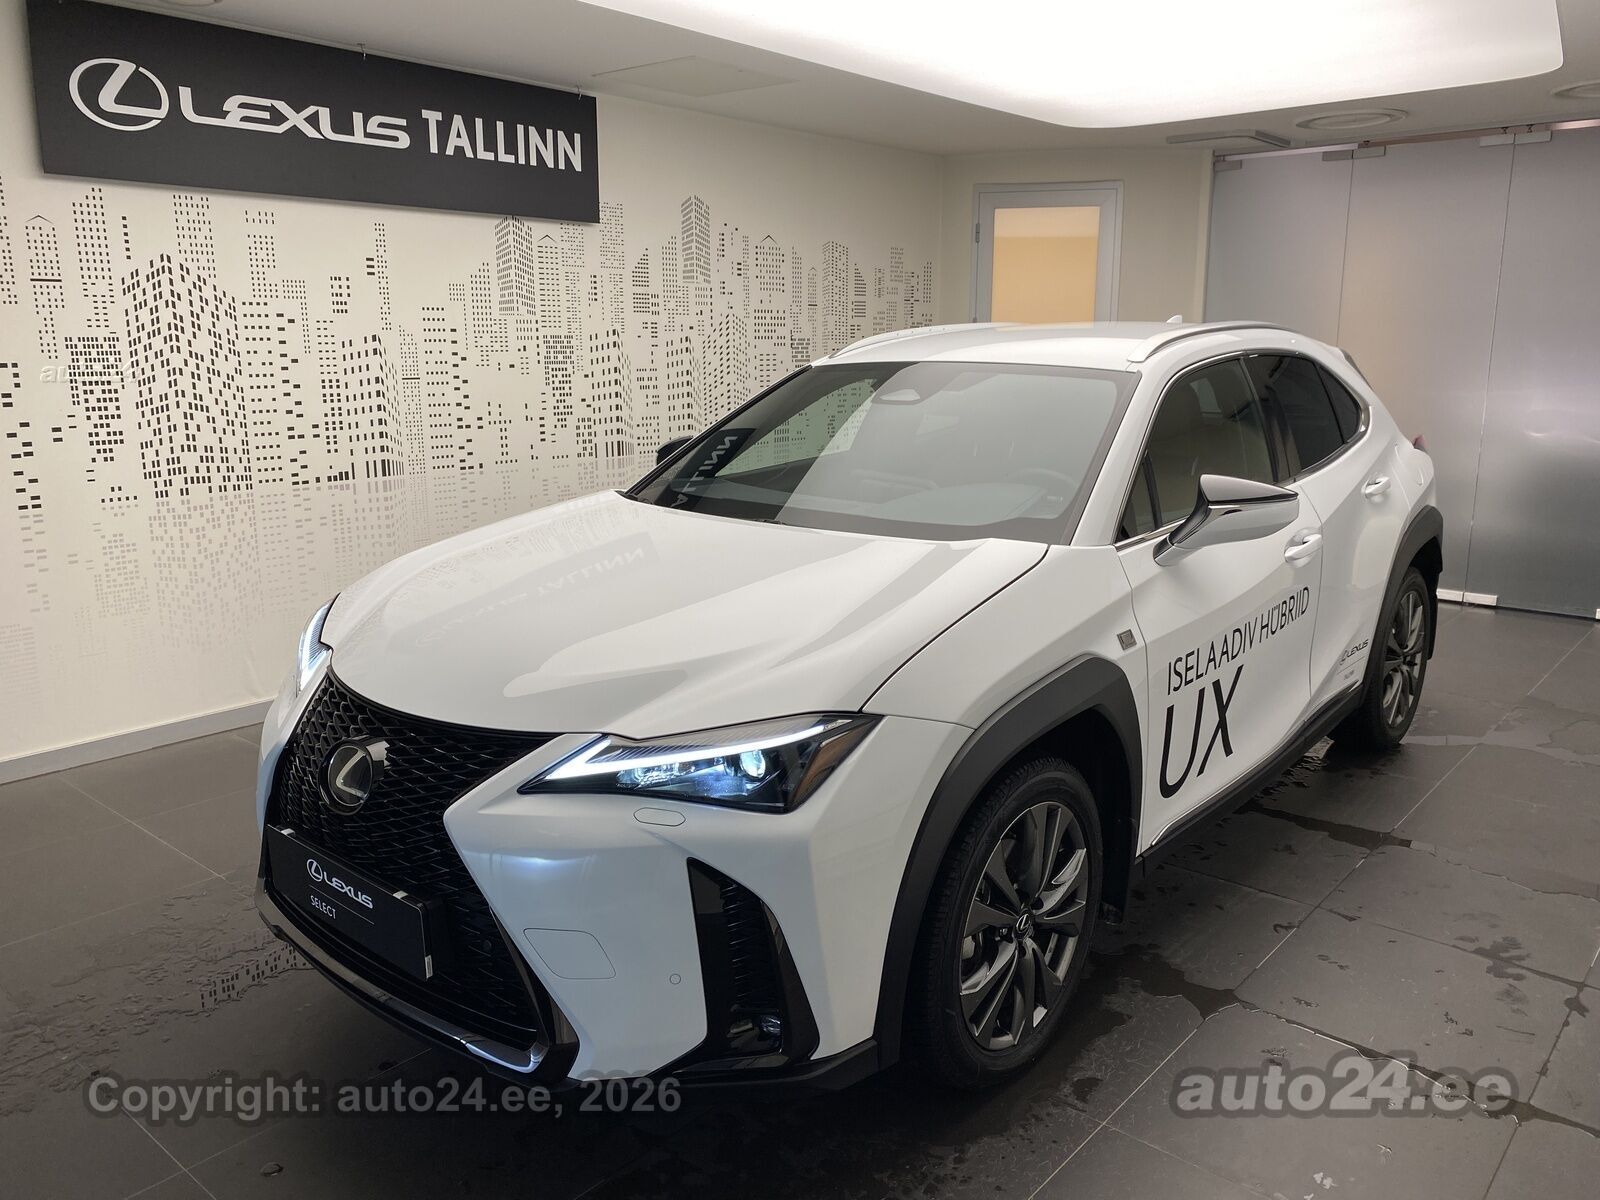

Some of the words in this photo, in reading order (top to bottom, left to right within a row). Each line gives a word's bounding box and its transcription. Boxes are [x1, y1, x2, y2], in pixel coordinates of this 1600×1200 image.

[178, 86, 411, 149] LEXUS
[421, 109, 582, 172] TALLINN
[1167, 617, 1258, 695] ISELAADIV
[1259, 586, 1310, 643] HÜBRIID
[1159, 664, 1244, 799] UX
[310, 895, 337, 920] SELECT
[323, 869, 374, 909] LEXUS
